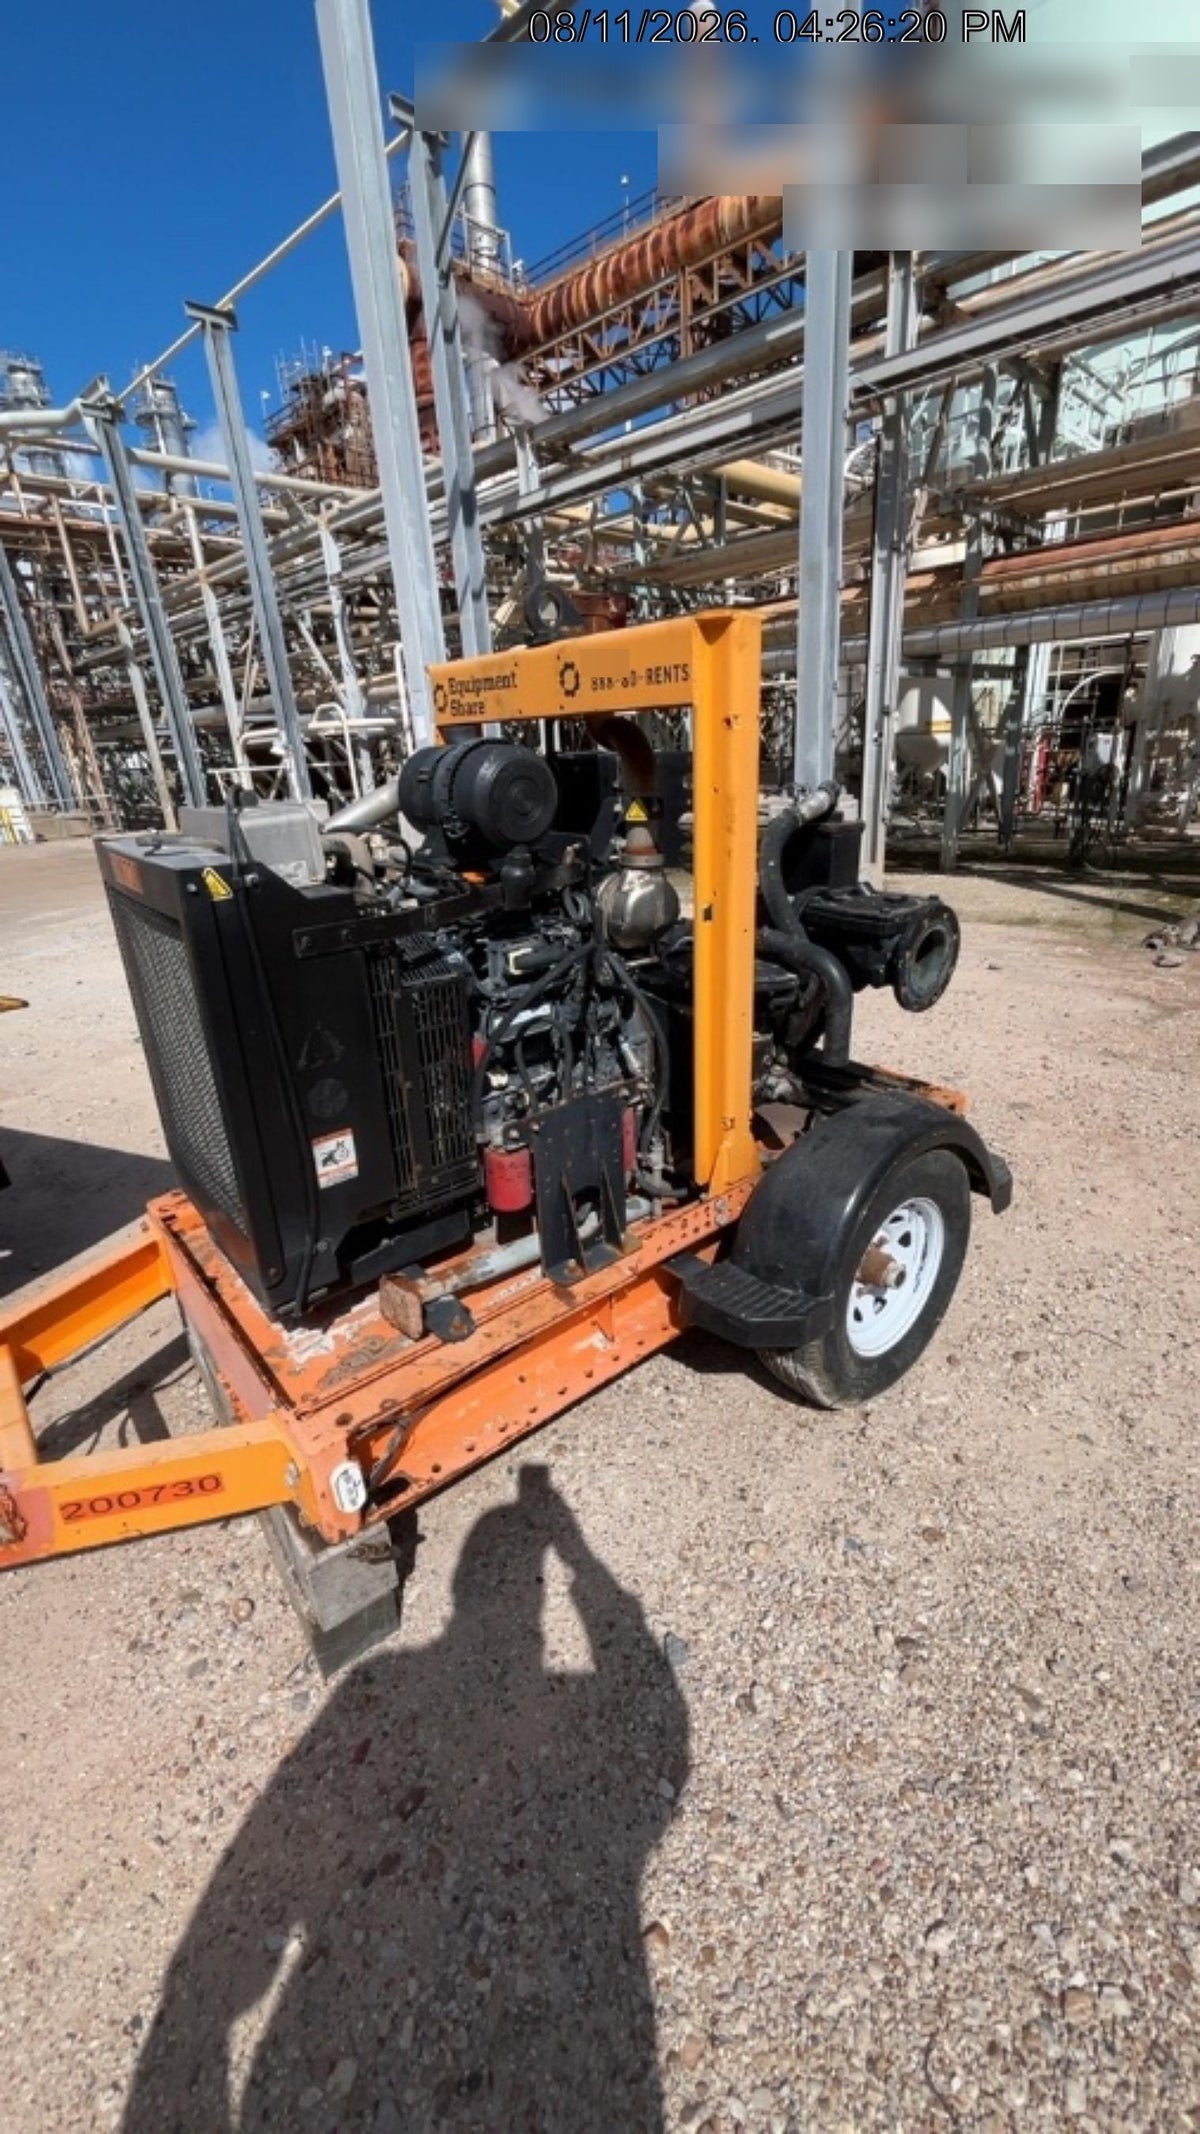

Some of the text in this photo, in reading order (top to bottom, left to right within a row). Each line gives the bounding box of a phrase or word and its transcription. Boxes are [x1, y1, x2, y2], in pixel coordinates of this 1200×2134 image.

[448, 671, 518, 698] Equipment
[450, 698, 485, 717] Share
[59, 1474, 222, 1521] 200730
